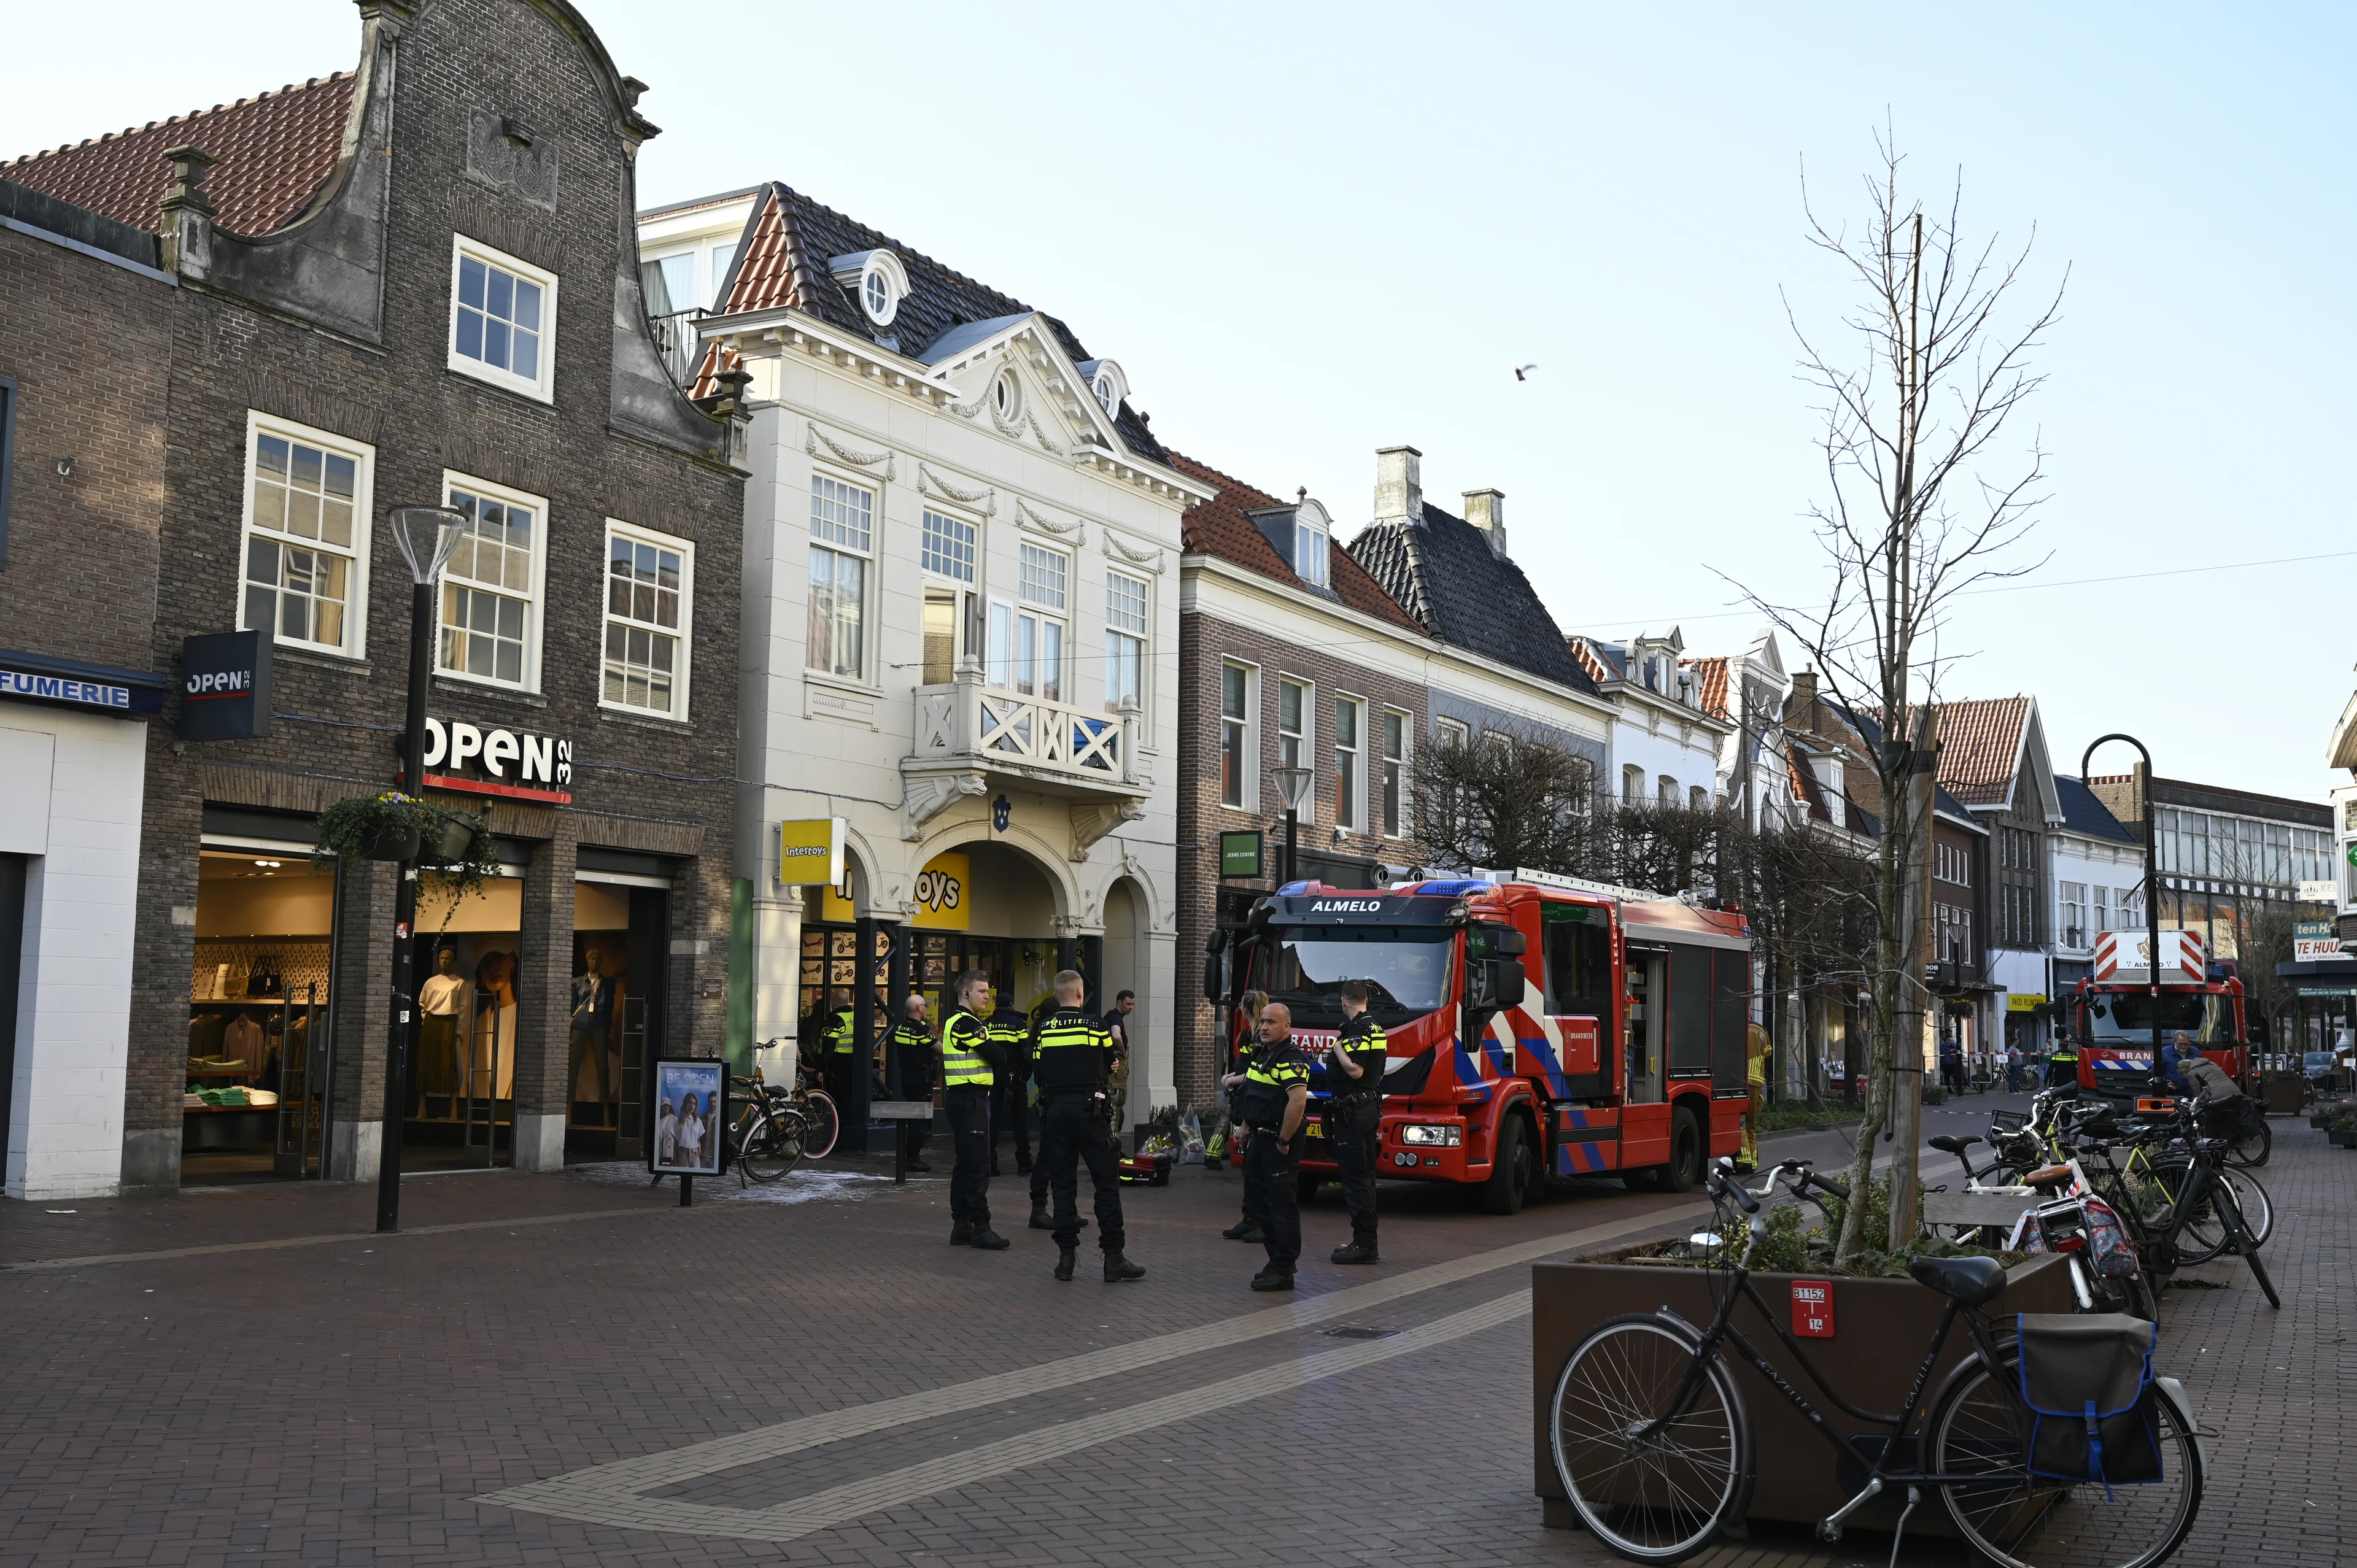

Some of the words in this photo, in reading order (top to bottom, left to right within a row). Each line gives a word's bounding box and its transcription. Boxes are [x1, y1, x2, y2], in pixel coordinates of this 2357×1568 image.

[243, 670, 250, 688] 32
[0, 672, 128, 706] FUMERIE
[557, 740, 572, 785] 32
[785, 845, 827, 857] Intertoys
[1310, 900, 1381, 913] ALMELO
[2297, 924, 2317, 935] ten
[2297, 942, 2310, 954] TE
[2119, 1052, 2153, 1060] BRAN
[667, 1073, 681, 1084] BE
[684, 1073, 714, 1084] OPEN
[1310, 1125, 1320, 1134] 21
[1794, 1288, 1824, 1299] B1152
[1811, 1319, 1822, 1329] 14
[1760, 1361, 1811, 1410] GAZELLE
[1905, 1359, 1932, 1410] GAZELLE
